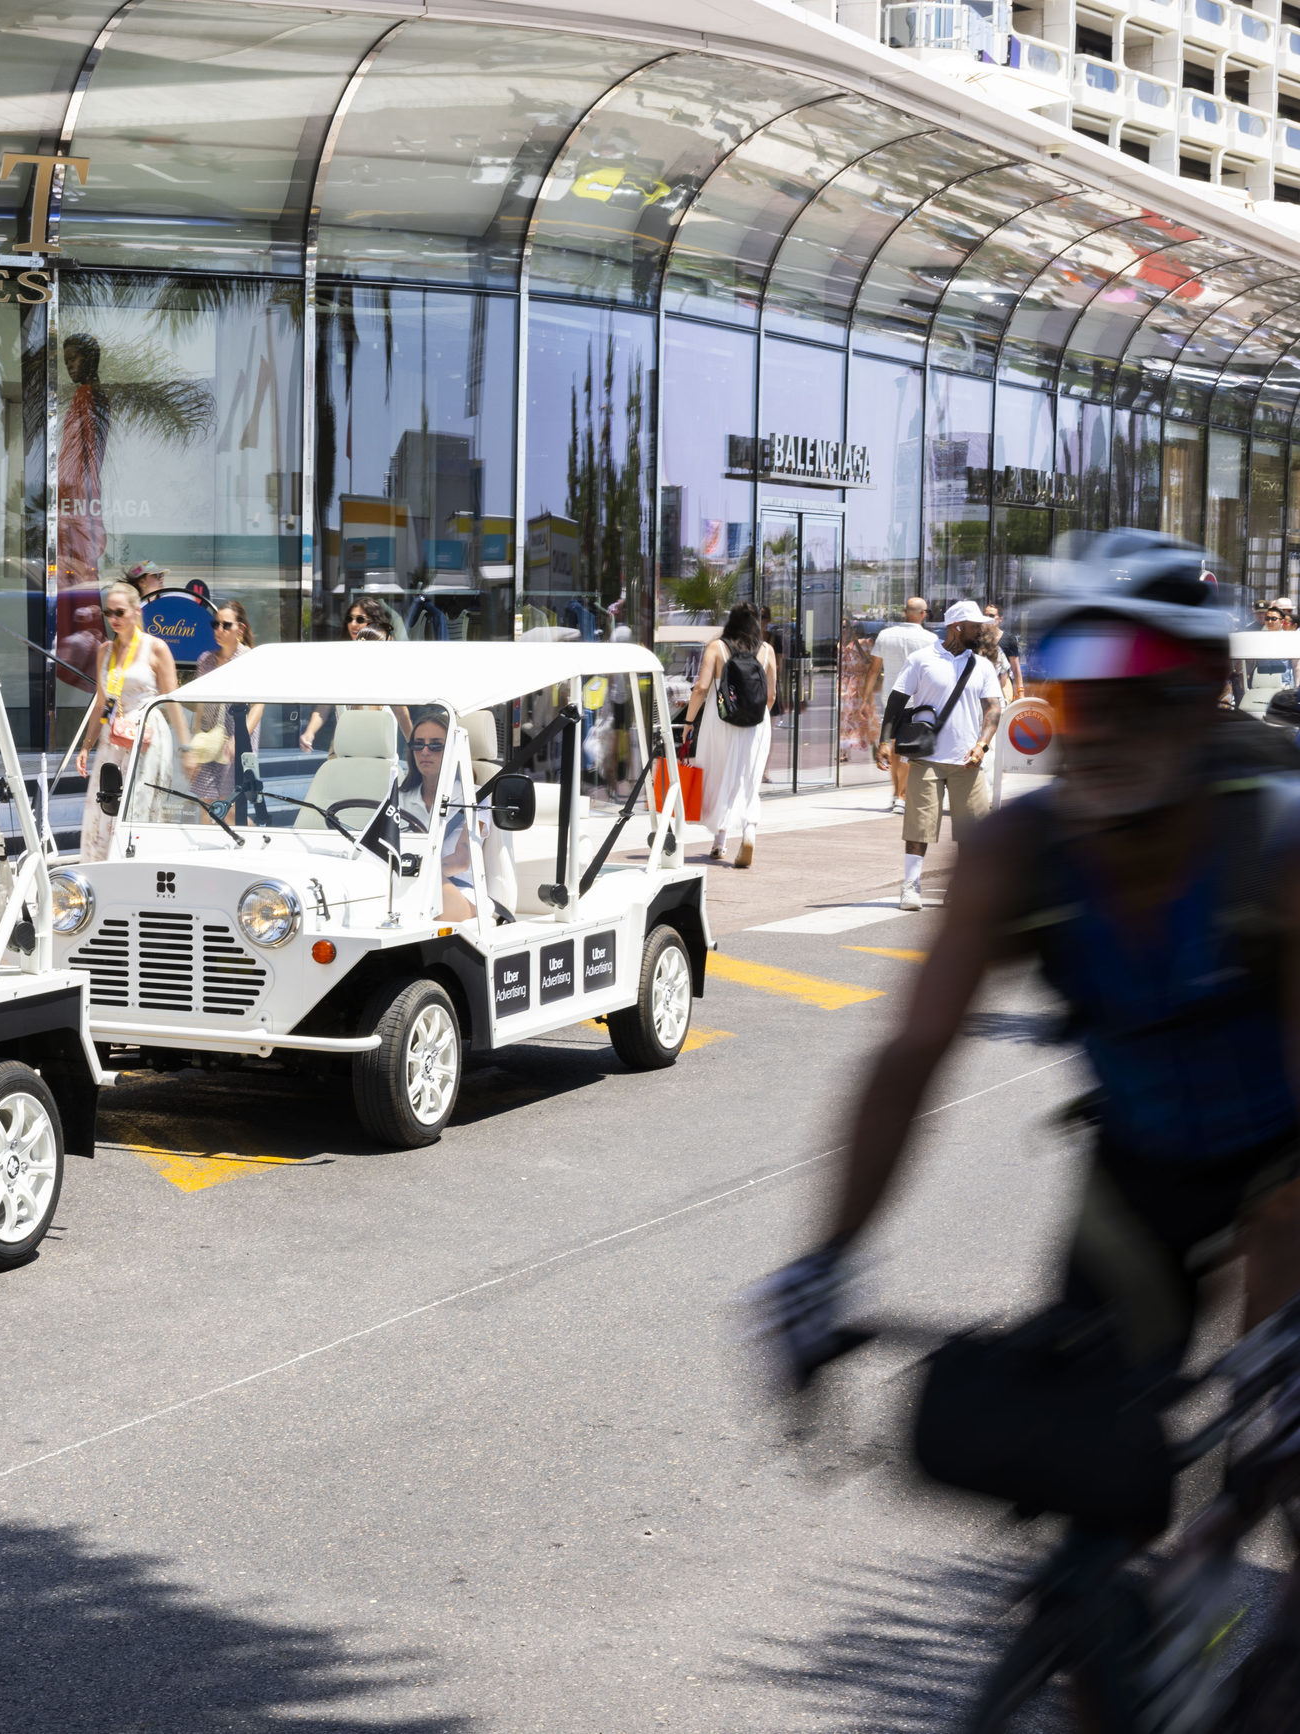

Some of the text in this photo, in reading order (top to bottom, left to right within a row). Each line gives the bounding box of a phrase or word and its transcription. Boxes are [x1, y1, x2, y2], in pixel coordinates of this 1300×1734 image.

[773, 432, 872, 477] BALENCIAGA
[147, 614, 197, 637] Scalini
[592, 947, 607, 961] Uber
[548, 957, 564, 972] Uber
[584, 960, 613, 978] Advertising
[503, 970, 520, 985] Uber
[541, 971, 571, 989] Advertising
[495, 984, 527, 1002] Advertising
